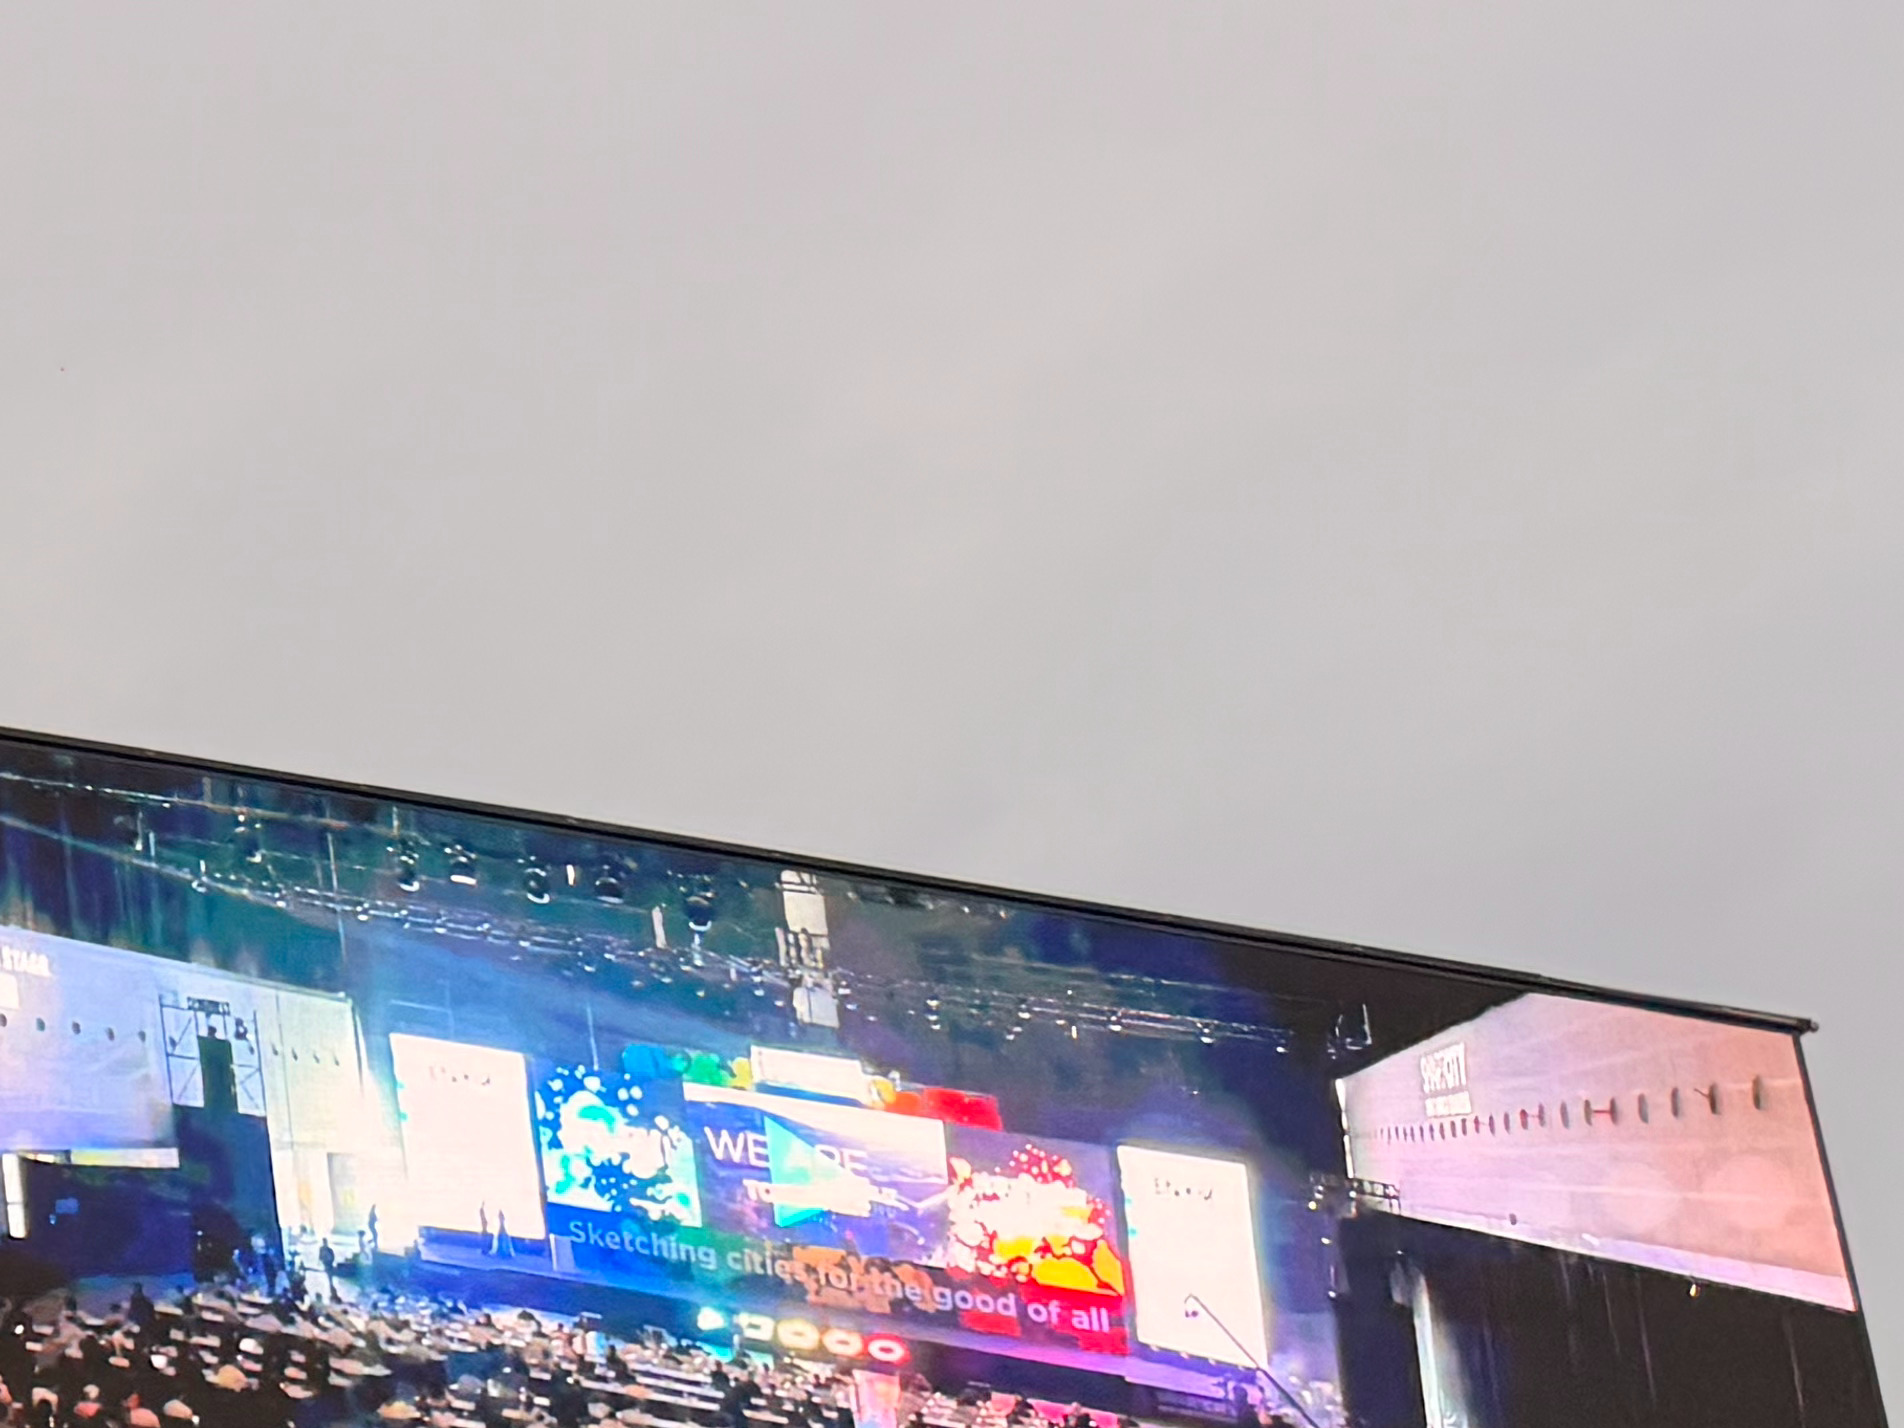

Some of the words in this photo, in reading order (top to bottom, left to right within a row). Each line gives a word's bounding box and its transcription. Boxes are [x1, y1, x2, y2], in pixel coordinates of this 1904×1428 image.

[703, 1125, 771, 1169] WE
[569, 1220, 718, 1271] Sketching
[726, 1246, 808, 1284] cities
[816, 1260, 866, 1292] for
[870, 1267, 924, 1300] the
[934, 1292, 1018, 1316] good
[1027, 1301, 1061, 1324] of
[1070, 1307, 1111, 1333] all
